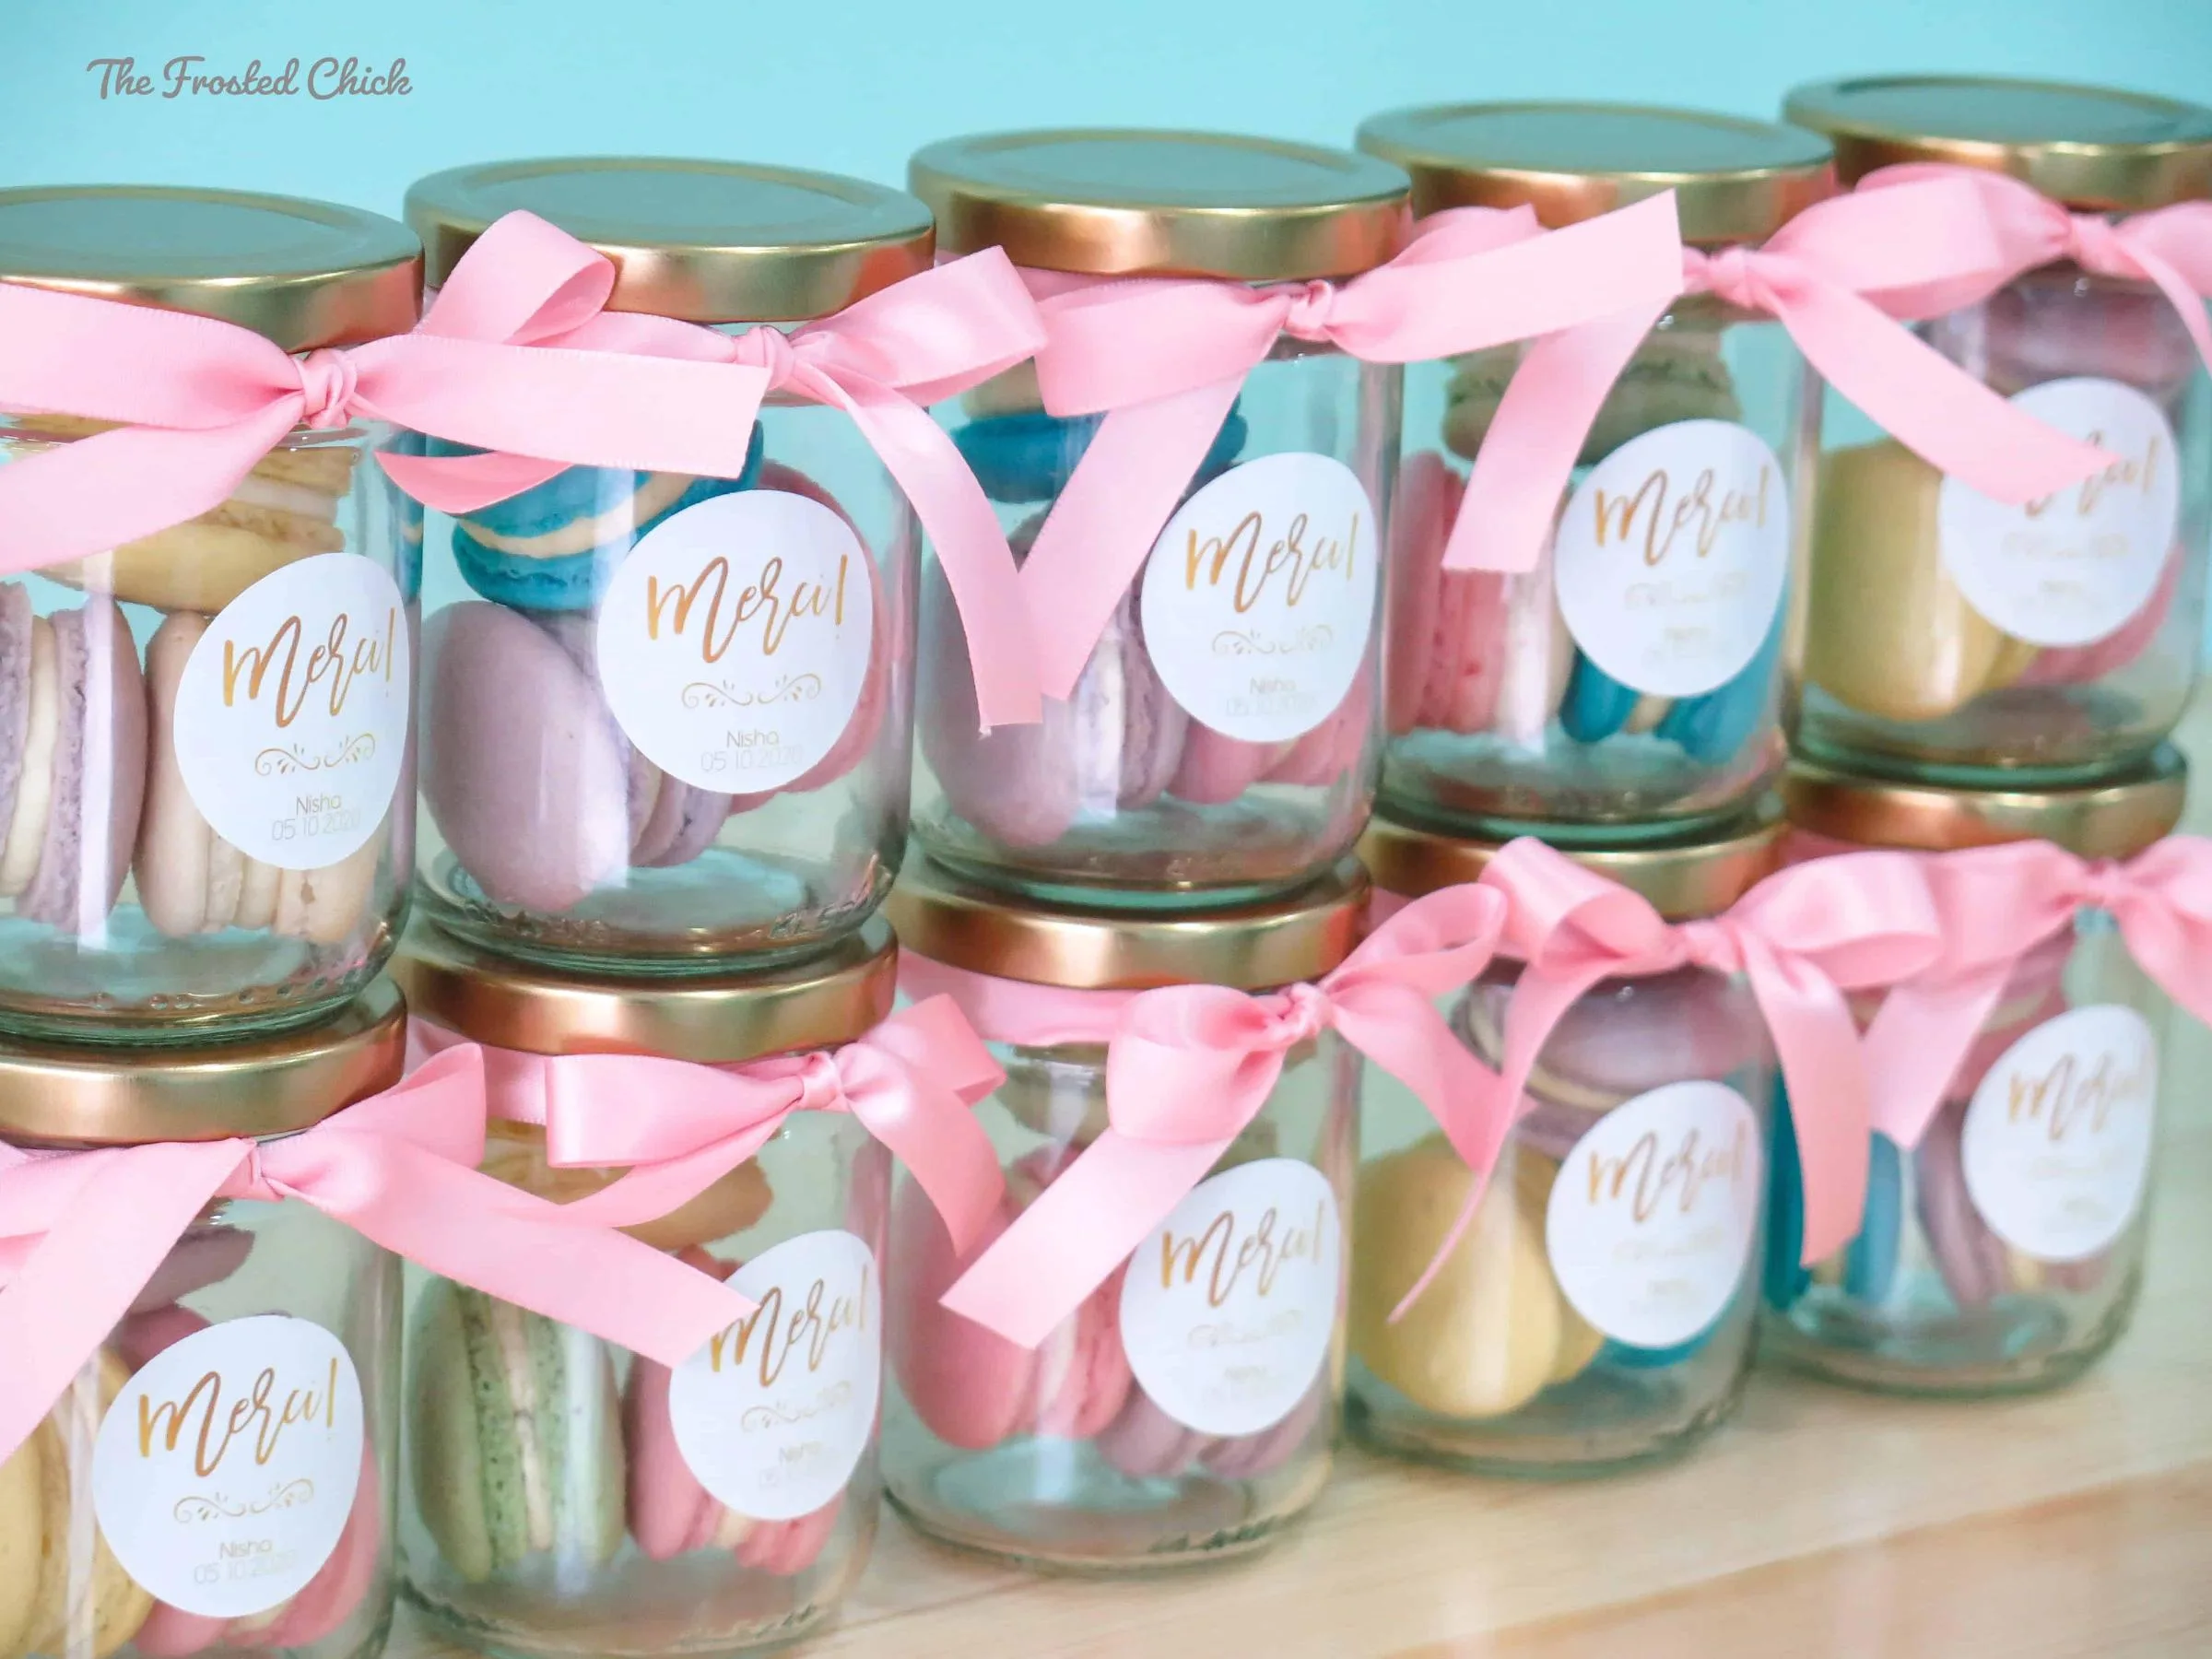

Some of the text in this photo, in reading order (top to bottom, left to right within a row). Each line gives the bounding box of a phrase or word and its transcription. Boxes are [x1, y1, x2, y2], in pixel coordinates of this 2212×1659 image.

[648, 554, 848, 663] Merci!
[1186, 512, 1358, 613] Merci!
[223, 607, 394, 727] Merci!
[726, 729, 780, 748] Nisha
[296, 793, 342, 816] Nisha
[139, 1357, 338, 1477] Merci!
[218, 1538, 273, 1559] Nisha
